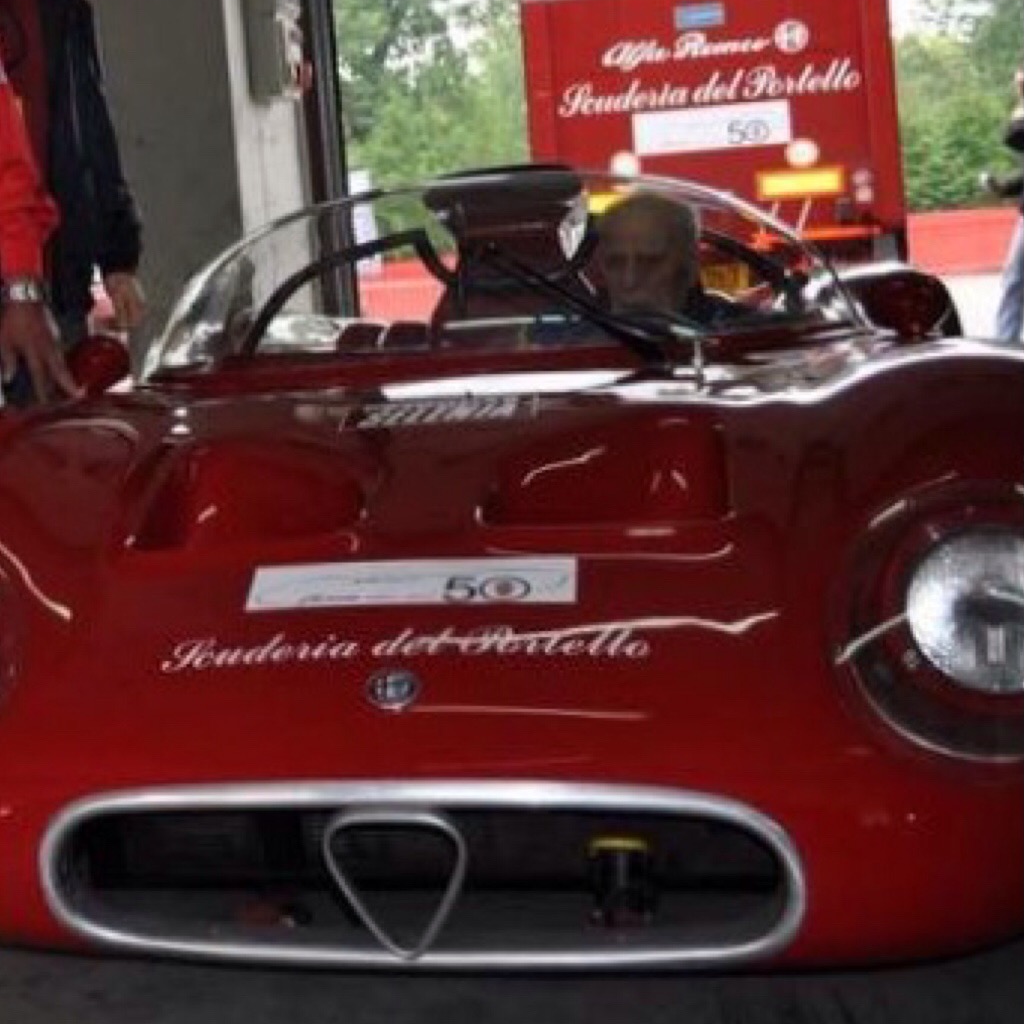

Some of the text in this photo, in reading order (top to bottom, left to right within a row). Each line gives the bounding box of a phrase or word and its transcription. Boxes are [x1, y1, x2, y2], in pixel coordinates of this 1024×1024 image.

[602, 31, 770, 71] Alfa Romeo
[558, 57, 862, 118] Scuderia del Portello
[161, 624, 652, 674] Scuderia del Portello
